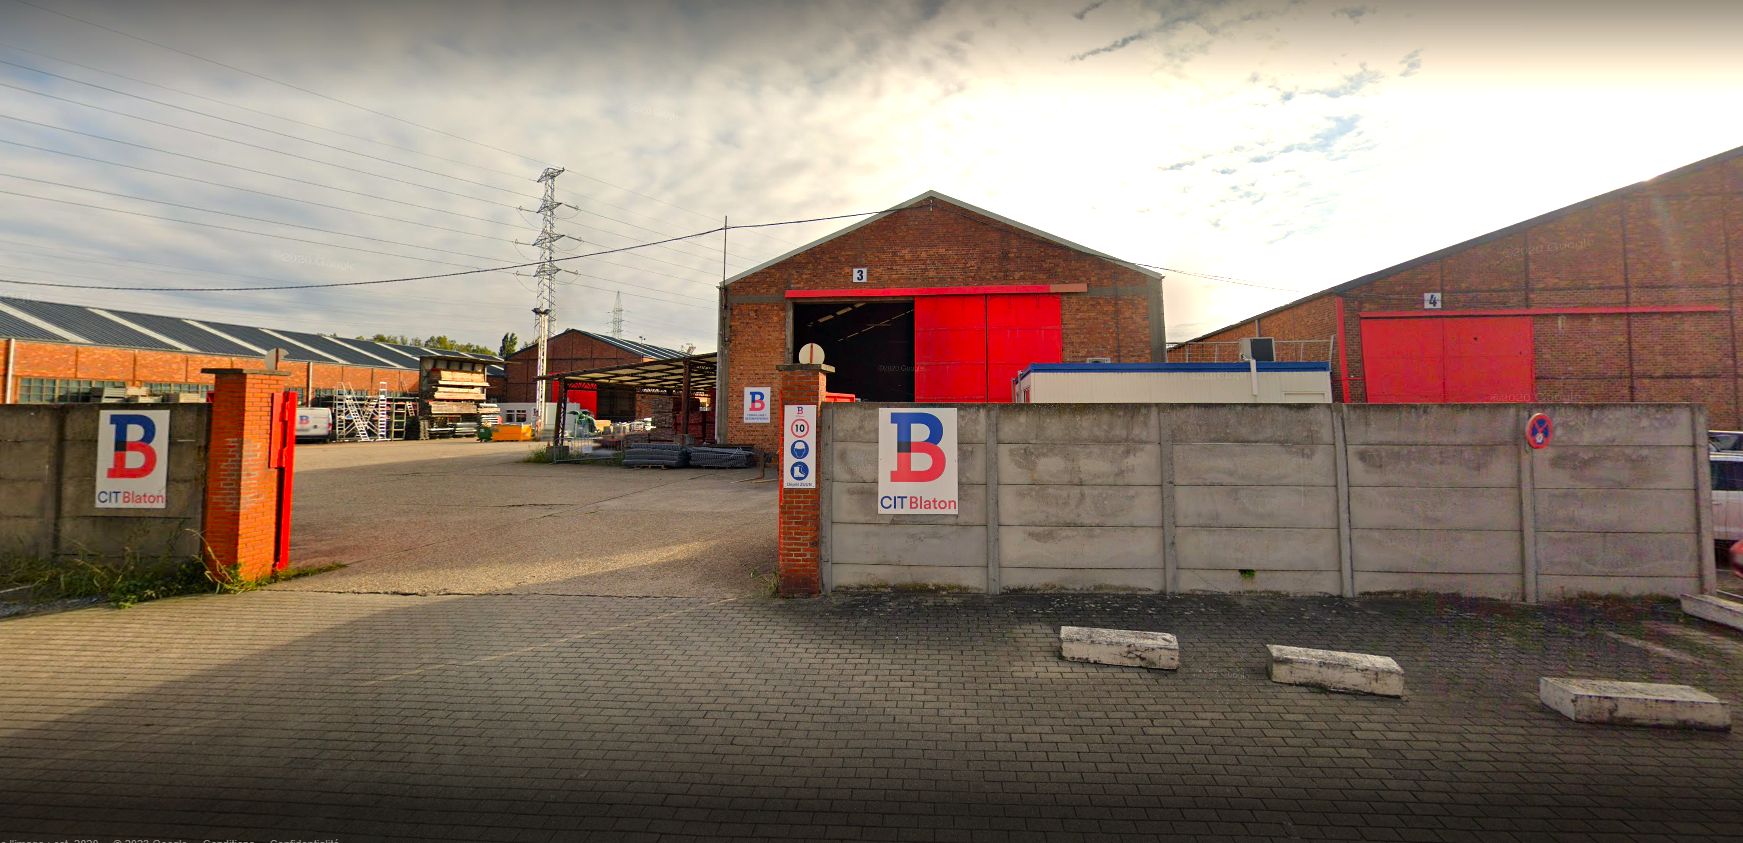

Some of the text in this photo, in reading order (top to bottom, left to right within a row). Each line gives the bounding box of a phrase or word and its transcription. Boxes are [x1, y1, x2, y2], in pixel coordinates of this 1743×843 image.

[857, 269, 864, 281] 3
[1429, 294, 1438, 307] 4
[749, 391, 765, 411] B
[795, 424, 805, 433] 10
[106, 414, 157, 479] B
[890, 412, 946, 482] B
